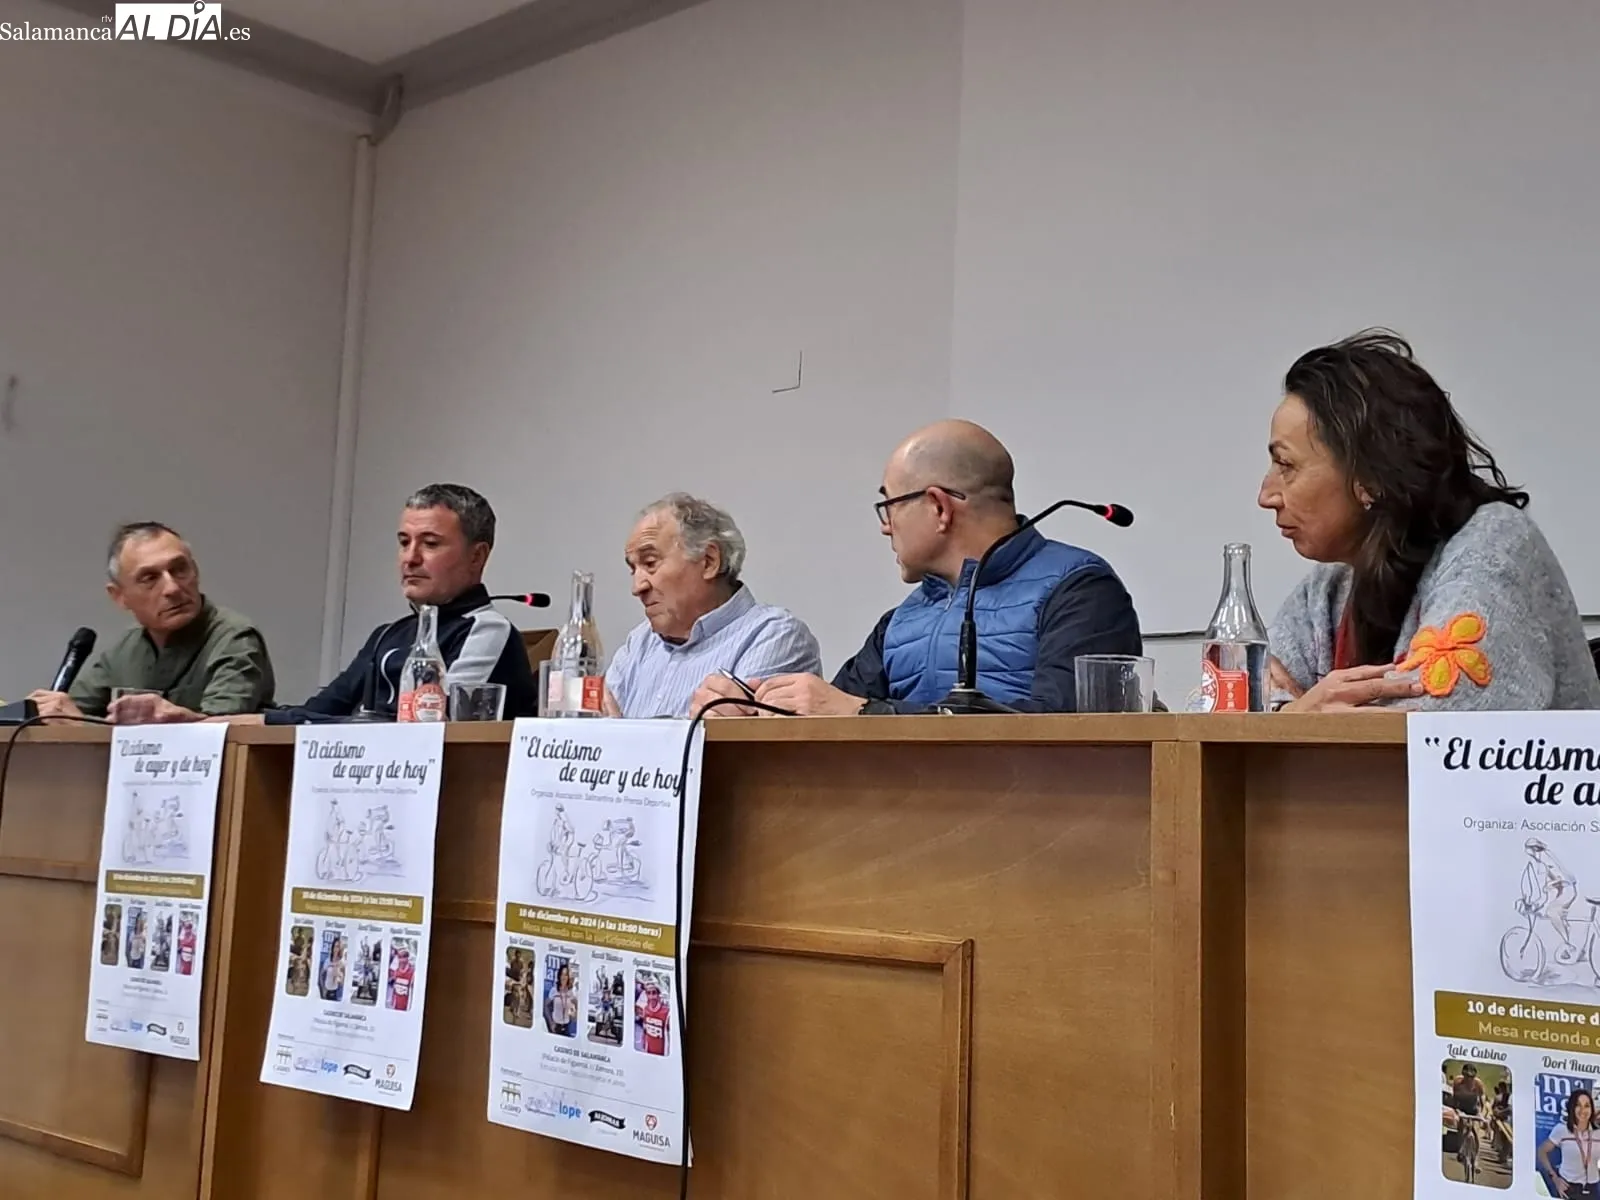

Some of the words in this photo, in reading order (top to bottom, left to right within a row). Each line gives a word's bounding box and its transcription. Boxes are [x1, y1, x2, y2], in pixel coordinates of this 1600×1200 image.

[319, 740, 366, 759] ciclismo
[542, 738, 602, 762] ciclismo
[333, 760, 347, 778] de
[348, 764, 374, 785] ayer
[376, 765, 384, 785] y
[385, 760, 401, 778] de
[559, 762, 577, 783] de
[580, 770, 615, 791] ayer
[618, 770, 629, 793] y
[632, 766, 650, 788] de
[1524, 773, 1564, 804] de
[1573, 782, 1600, 806] a
[1464, 816, 1517, 831] Organiza:
[1520, 818, 1586, 832] Asociación
[1590, 820, 1600, 833] S
[1467, 1001, 1484, 1014] 10
[1487, 1002, 1505, 1016] de
[1509, 1004, 1586, 1025] diciembre
[1478, 1021, 1518, 1038] Mesa
[1524, 1028, 1590, 1047] redonda
[1447, 1043, 1468, 1058] Lale
[1471, 1046, 1507, 1061] Cubino
[1542, 1056, 1567, 1070] Dori
[560, 1100, 581, 1119] lope
[632, 1129, 671, 1148] MAGUISA
